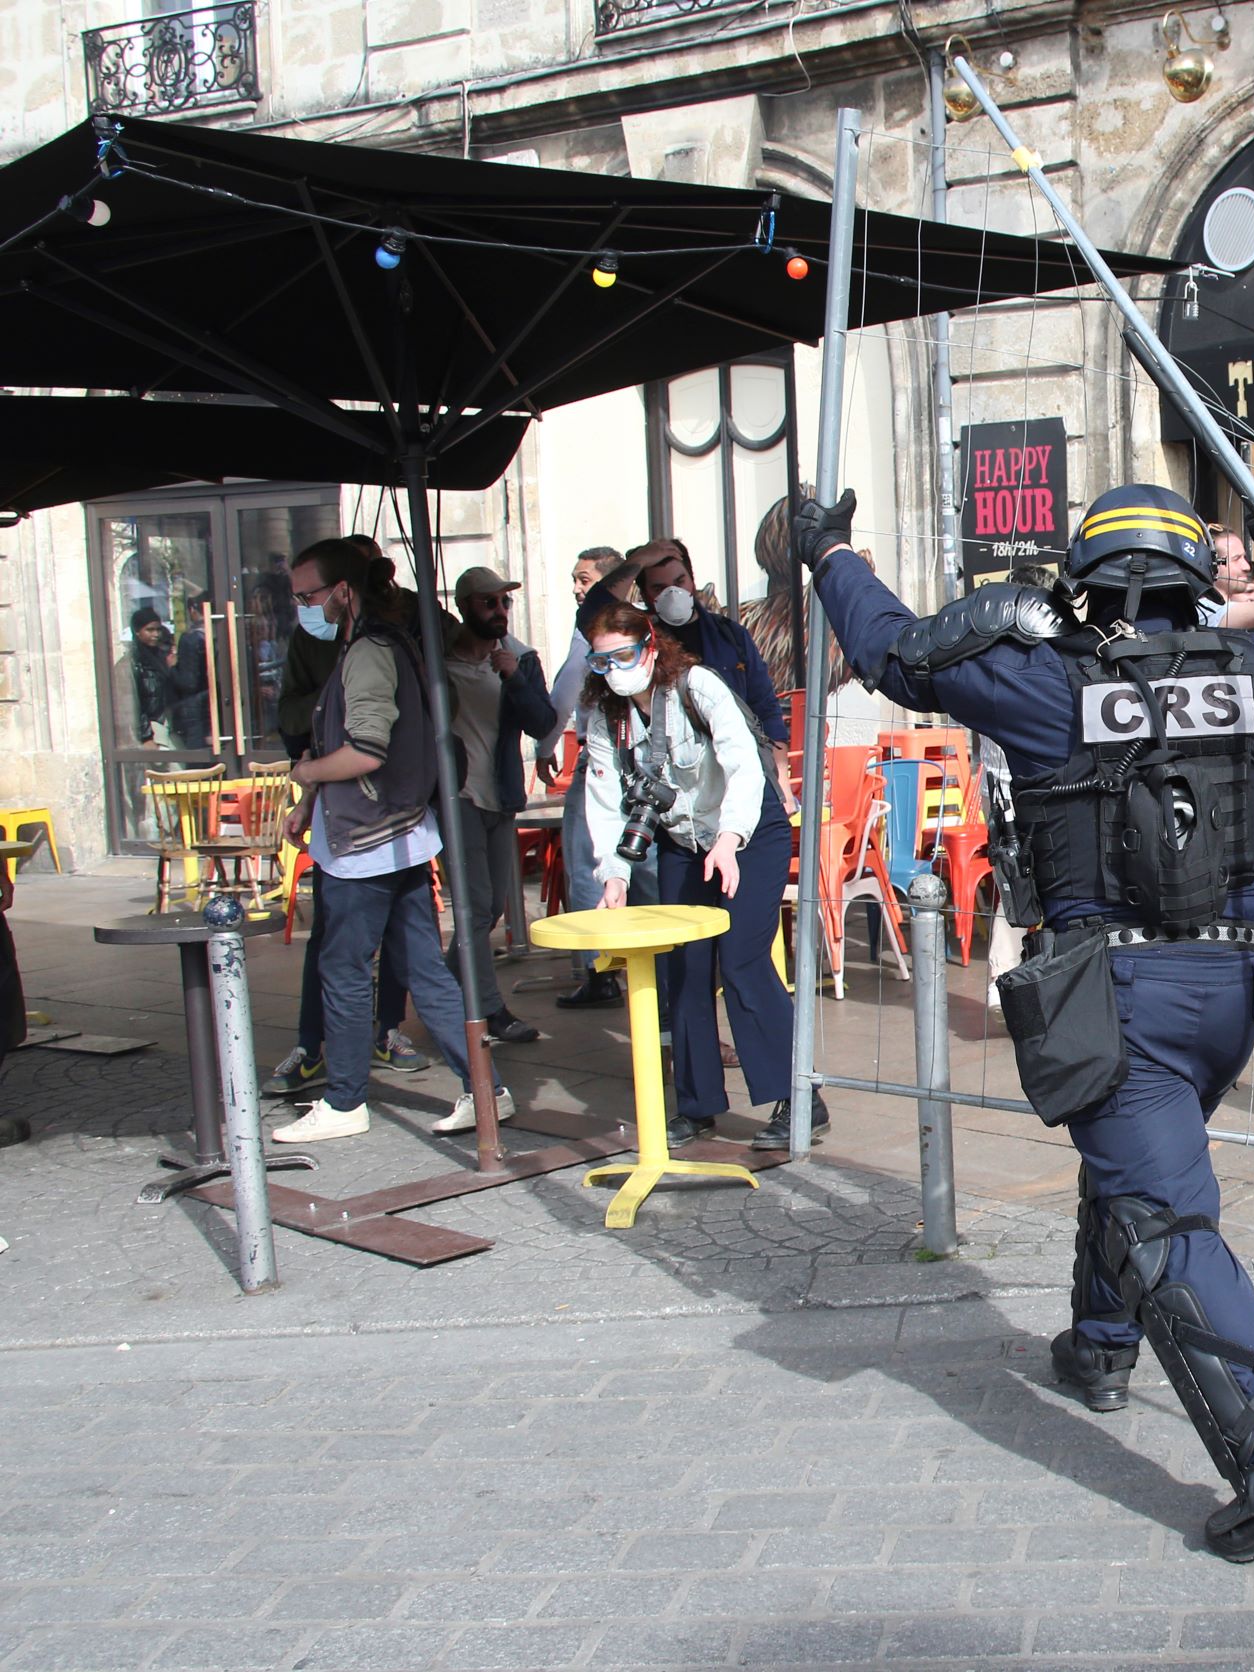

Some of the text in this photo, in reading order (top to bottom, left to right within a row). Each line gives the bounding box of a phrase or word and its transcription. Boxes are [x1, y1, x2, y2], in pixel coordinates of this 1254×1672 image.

[974, 445, 1053, 488] HAPPY
[974, 488, 1056, 535] HOUR
[992, 540, 1039, 557] 18h/21h
[1183, 542, 1196, 558] 22
[1100, 682, 1241, 734] CRS
